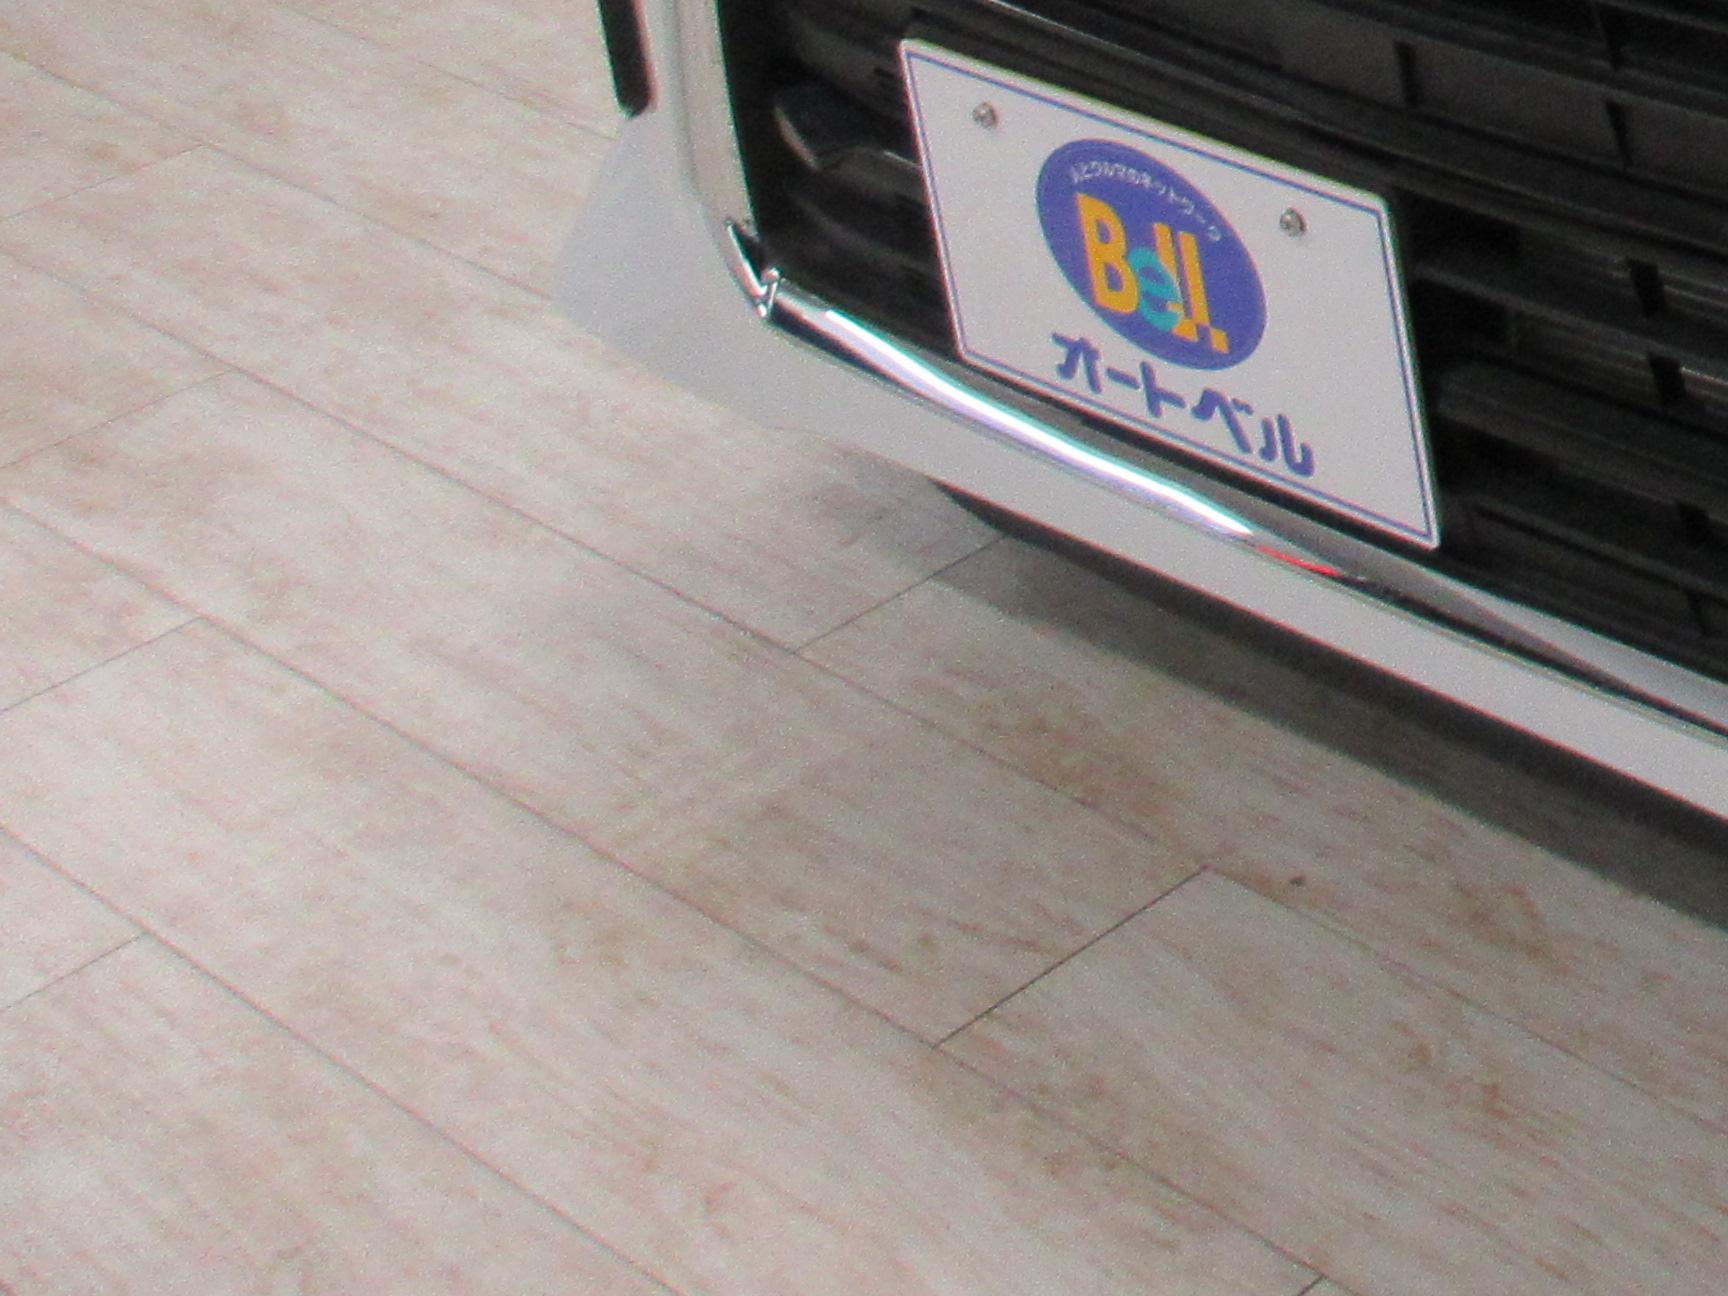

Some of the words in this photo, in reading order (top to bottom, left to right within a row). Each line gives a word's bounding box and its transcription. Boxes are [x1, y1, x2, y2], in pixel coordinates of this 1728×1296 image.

[1050, 330, 1314, 477] オートベル
